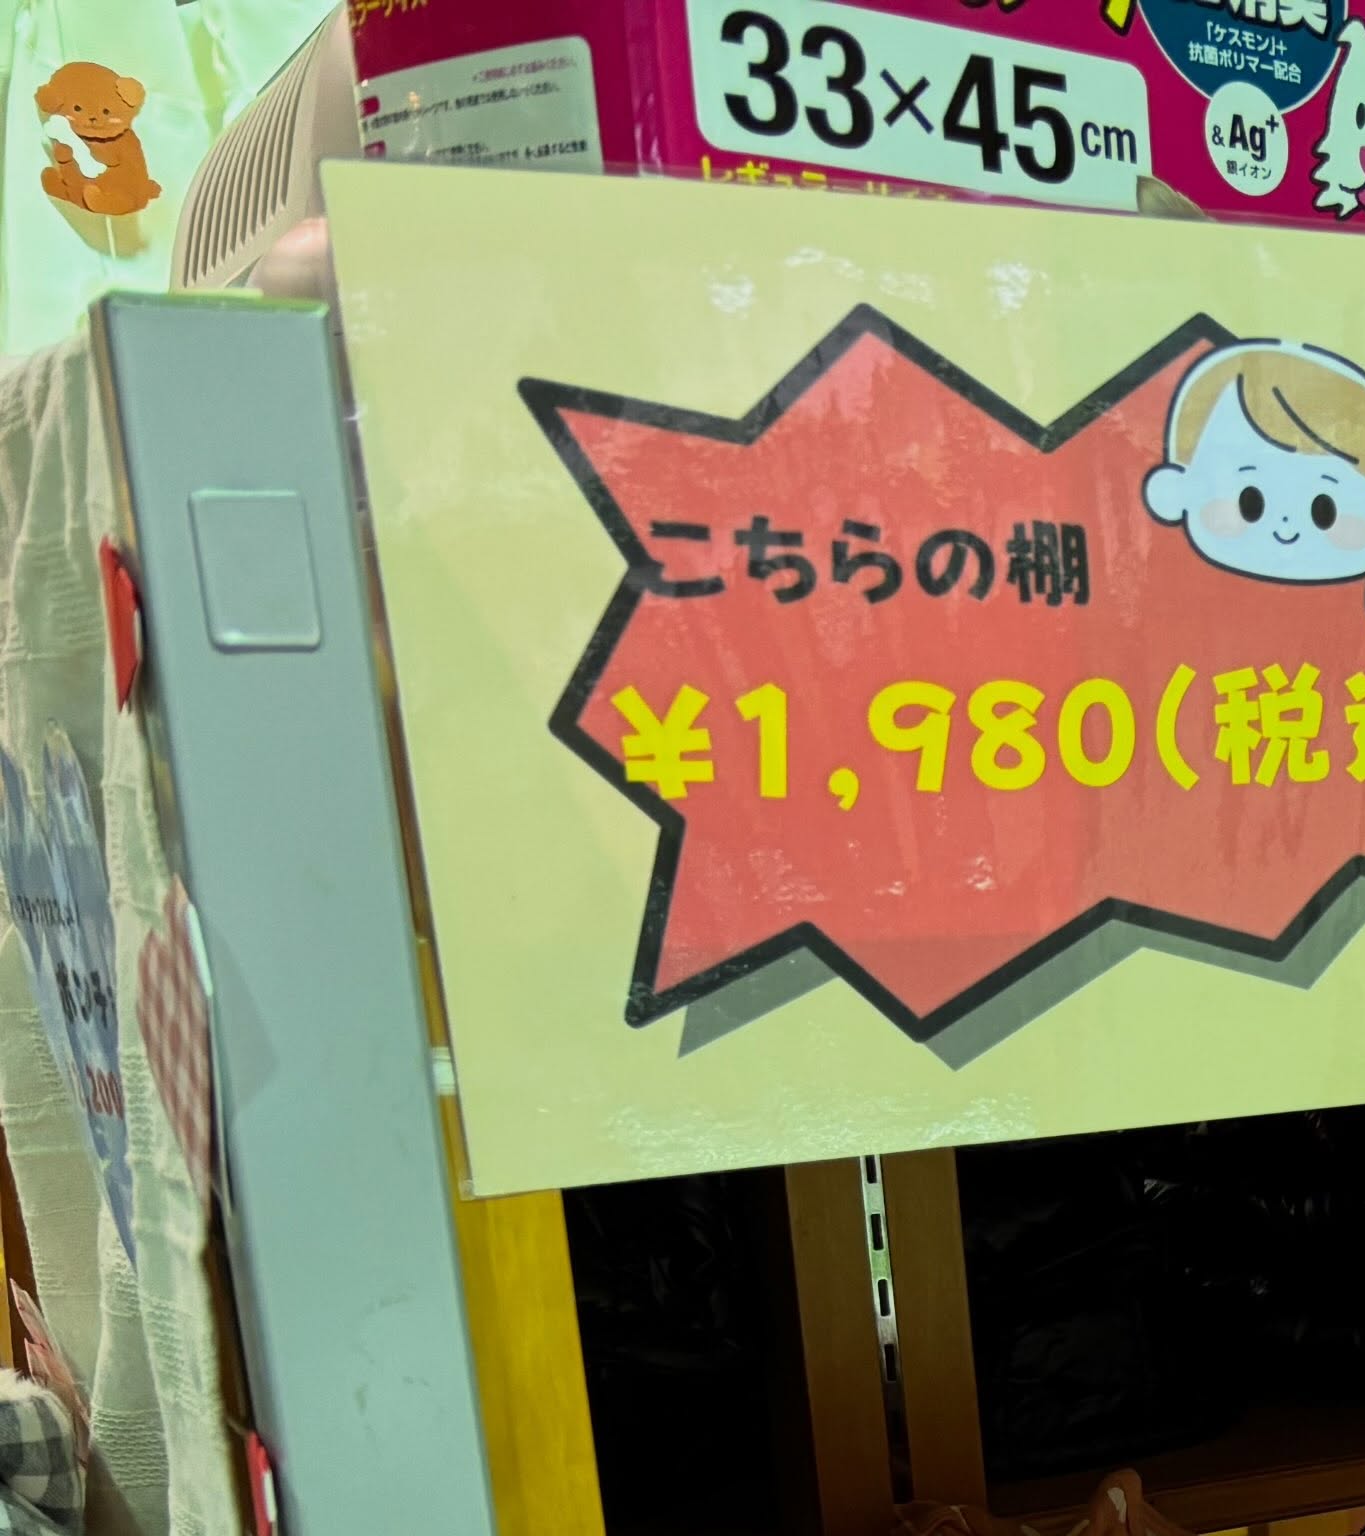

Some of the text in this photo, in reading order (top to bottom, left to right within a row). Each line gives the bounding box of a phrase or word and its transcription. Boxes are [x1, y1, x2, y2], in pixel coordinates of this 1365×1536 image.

[1187, 41, 1303, 84] 抗菌ポリマー配合
[641, 514, 1092, 607] こちらの棚
